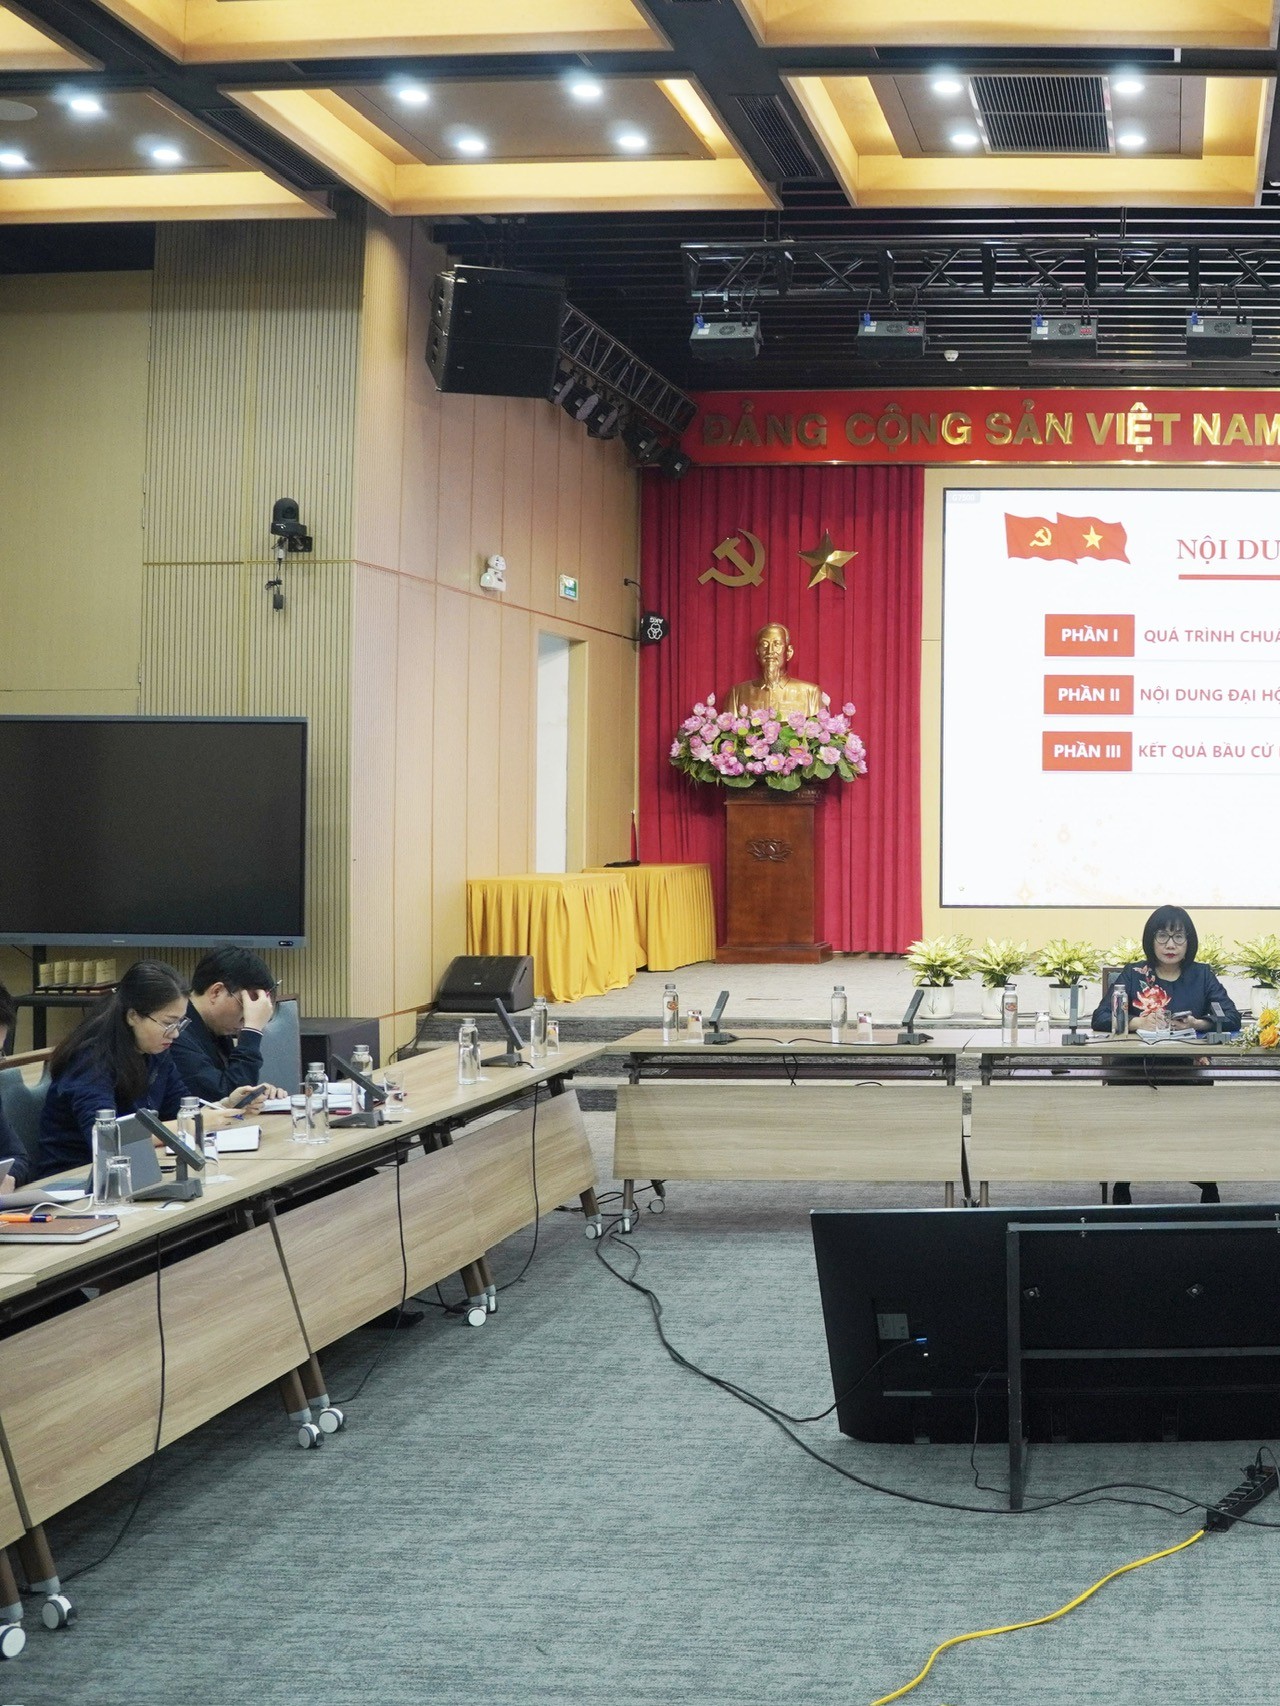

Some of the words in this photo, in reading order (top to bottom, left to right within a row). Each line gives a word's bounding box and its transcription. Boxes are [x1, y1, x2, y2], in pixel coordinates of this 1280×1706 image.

[703, 401, 828, 447] ĐẢNG
[845, 402, 972, 453] CỘNG
[985, 399, 1073, 447] SẢN
[1086, 401, 1182, 453] VIỆT
[1176, 535, 1229, 564] NỘI
[1061, 624, 1109, 642] PHẦN
[1113, 628, 1118, 642] I
[1144, 626, 1179, 643] QUÁ
[1184, 626, 1234, 643] TRÌNH
[1058, 684, 1105, 702] PHẦN
[1110, 688, 1120, 702] II
[1140, 686, 1169, 704] NỘI
[1175, 688, 1223, 701] DUNG
[1228, 689, 1256, 704] ĐẠI
[1053, 740, 1100, 758] PHẦN
[1106, 744, 1121, 758] III
[1139, 742, 1167, 758] KẾT
[1172, 742, 1206, 759] QUẢ
[1213, 742, 1245, 758] BẦU
[1251, 742, 1274, 758] CỬ
